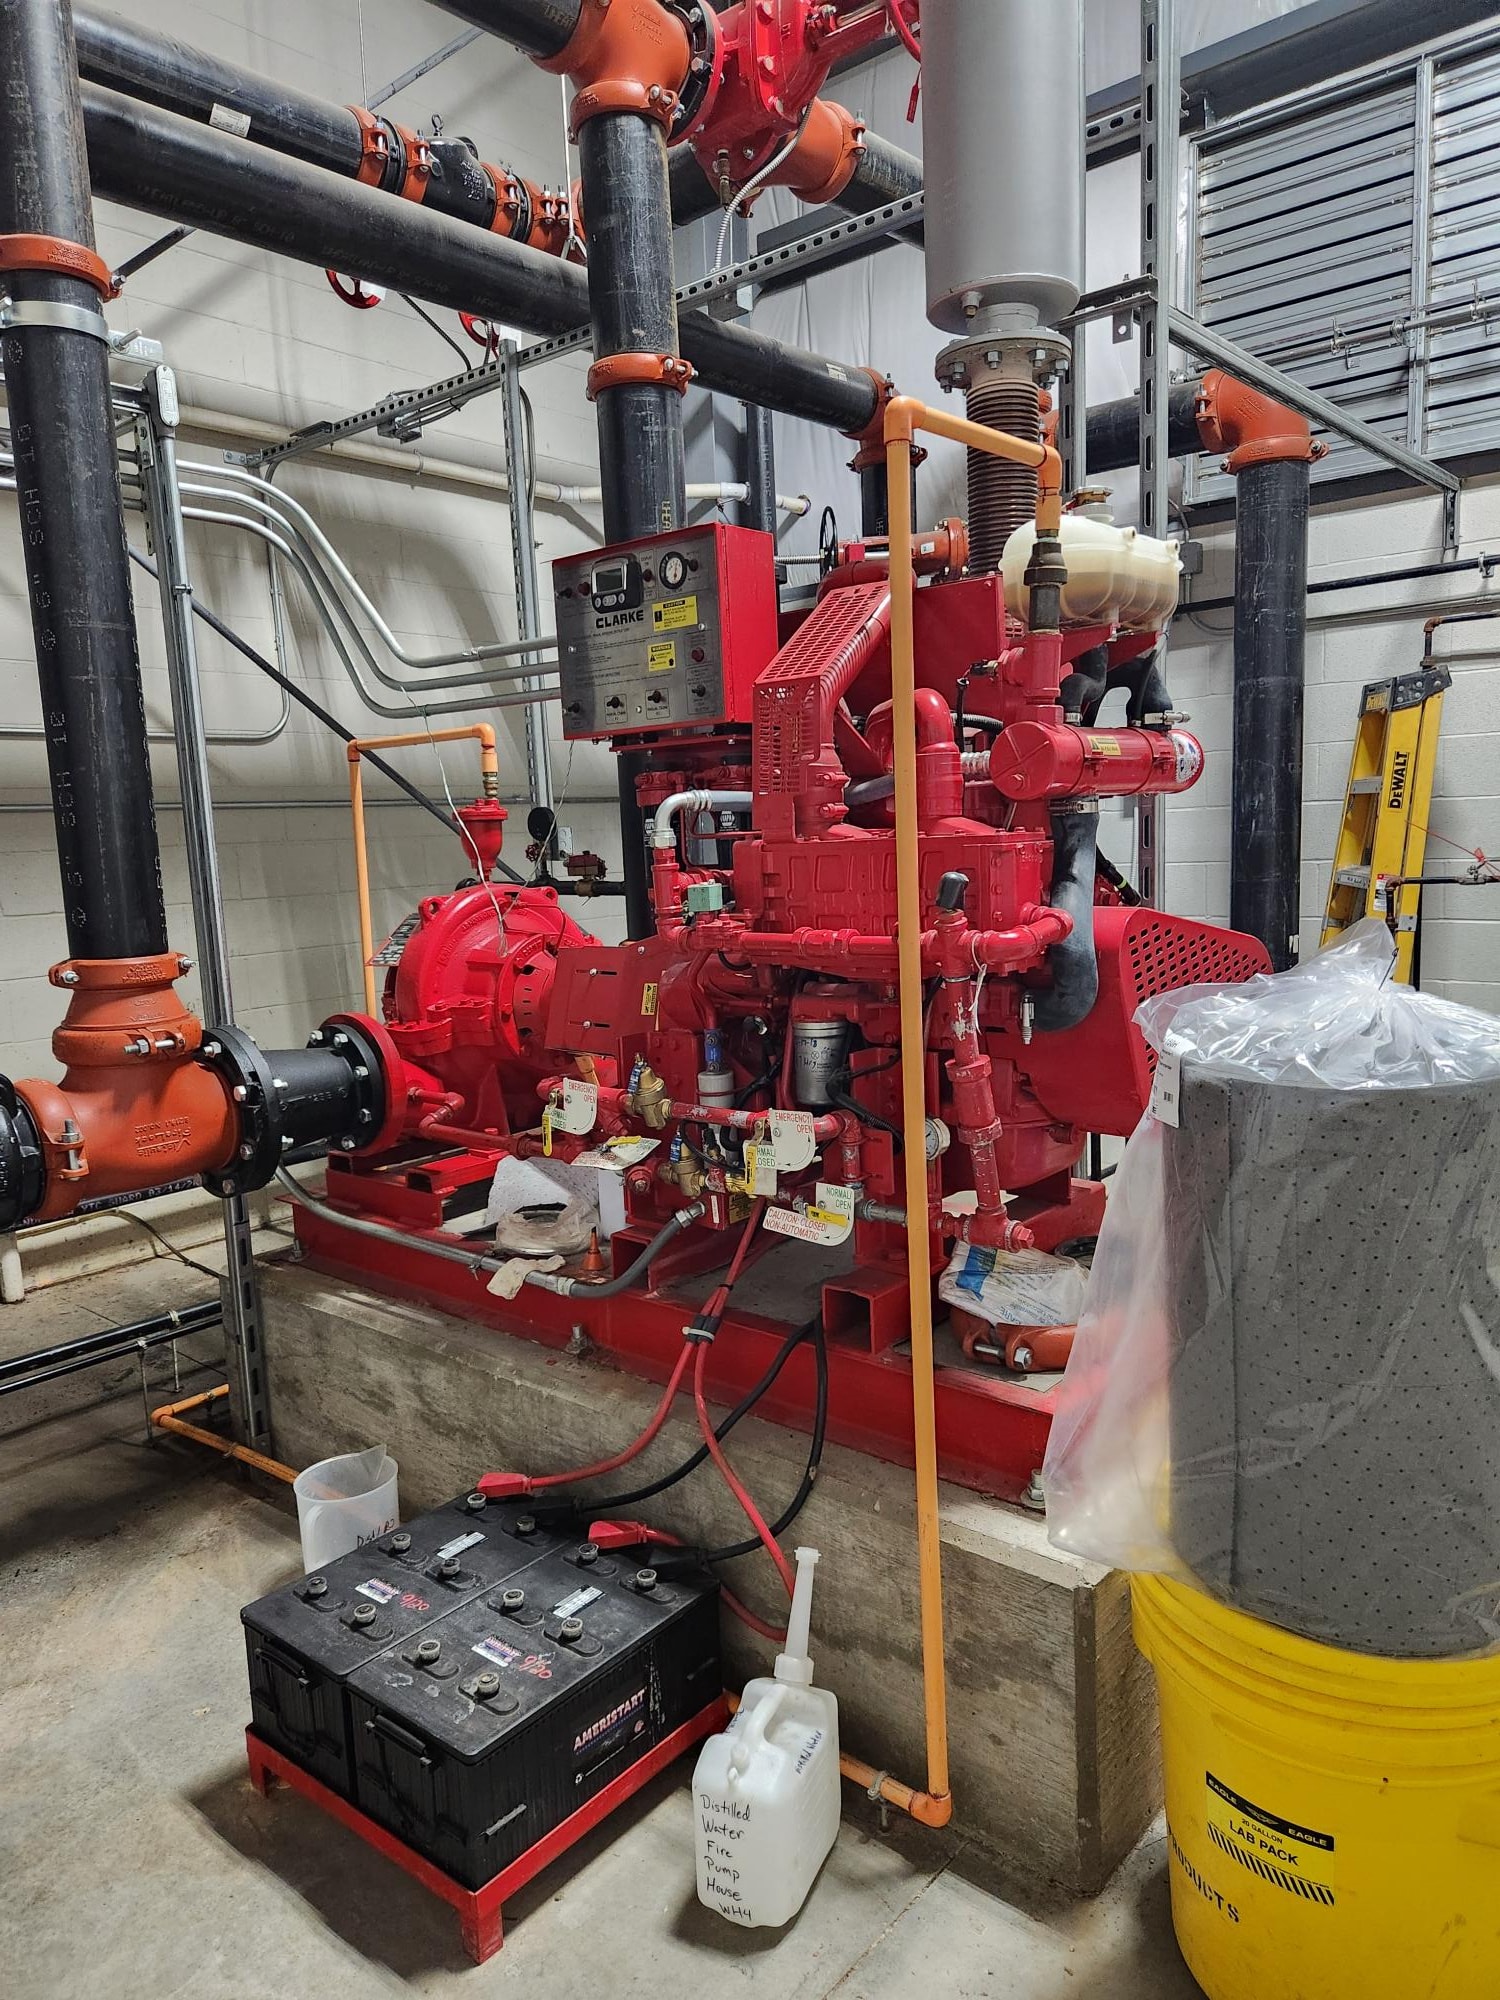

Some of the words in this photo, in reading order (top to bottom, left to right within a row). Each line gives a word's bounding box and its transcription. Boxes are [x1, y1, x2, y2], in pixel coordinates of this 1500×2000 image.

[24, 487, 45, 546] SCH
[595, 610, 644, 628] CLARKE
[56, 771, 77, 828] SCH
[584, 1094, 596, 1104] OPEN
[796, 1124, 813, 1134] OPEN
[835, 1200, 852, 1210] OPEN
[764, 1219, 820, 1241] NON-AUTOMATIC
[573, 1688, 646, 1752] AMERISTART
[1208, 1779, 1238, 1805] EAGLE
[700, 1794, 751, 1822] Distilled
[702, 1814, 745, 1840] Water
[1241, 1818, 1250, 1827] 20
[1251, 1825, 1283, 1844] GALLON
[1288, 1828, 1327, 1847] EAGLE
[706, 1839, 733, 1858] Fire
[1229, 1819, 1255, 1845] LAB
[1259, 1839, 1299, 1866] PACK
[703, 1855, 740, 1883] Pump
[706, 1877, 742, 1901] House
